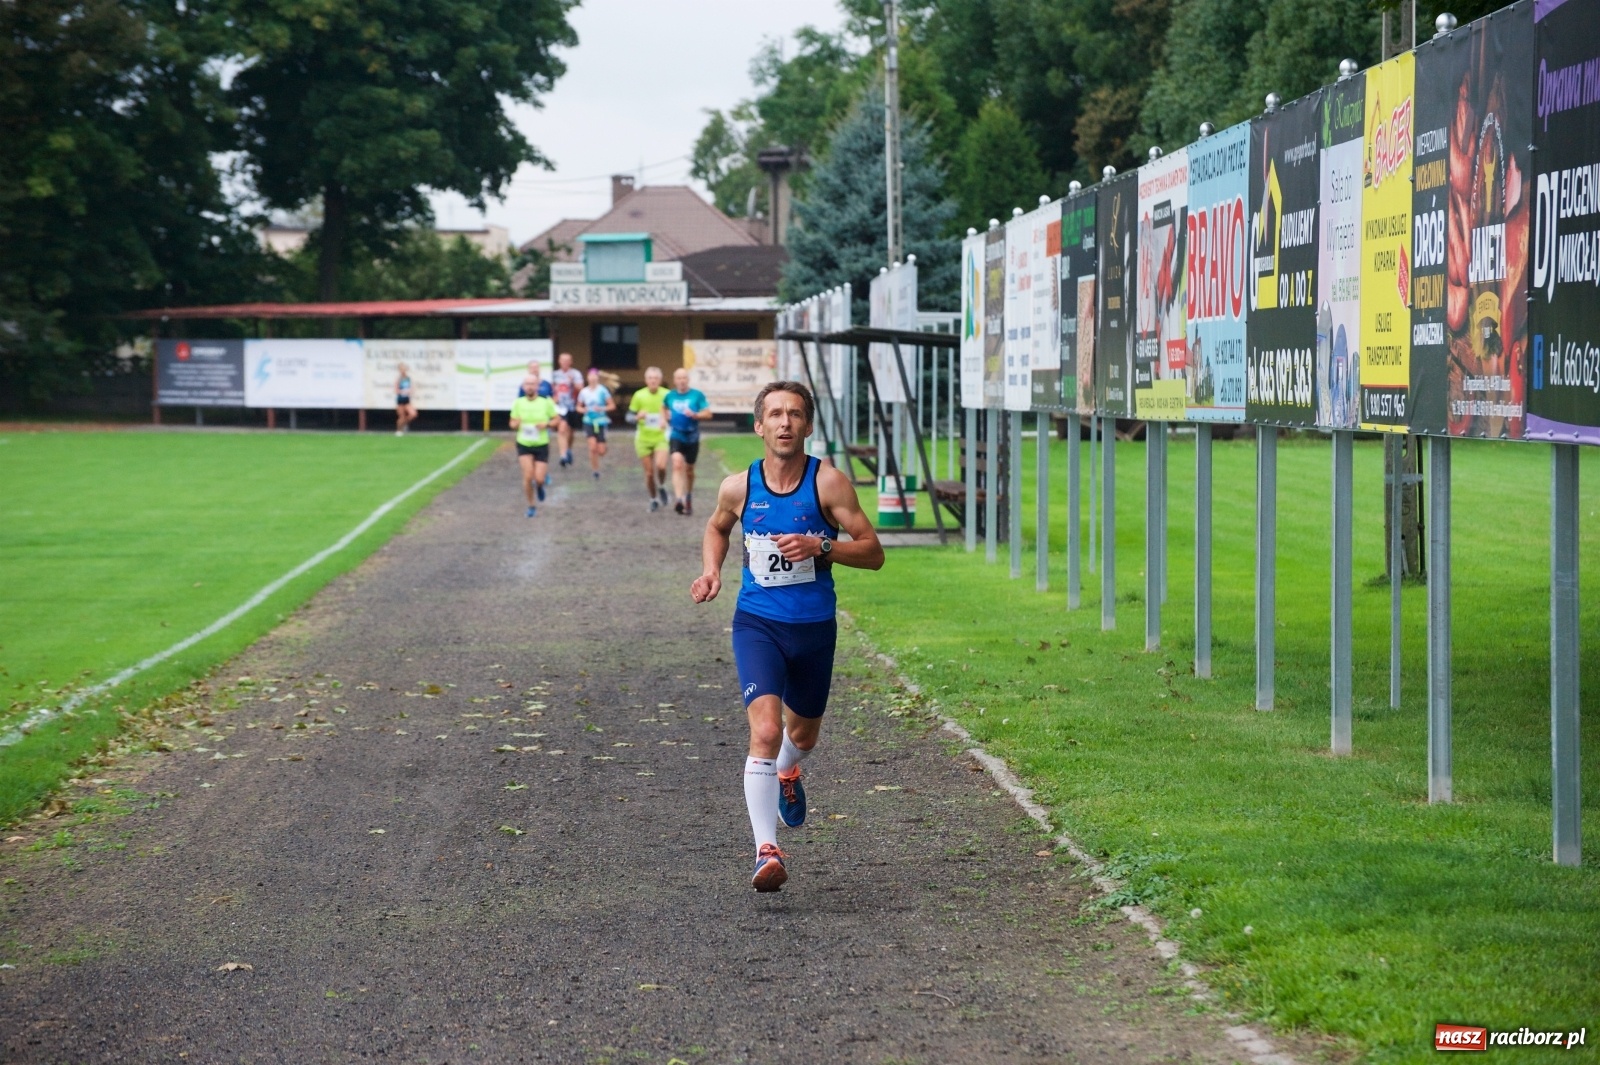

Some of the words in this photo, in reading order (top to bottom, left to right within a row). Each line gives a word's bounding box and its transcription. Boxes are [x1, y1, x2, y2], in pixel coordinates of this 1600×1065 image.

[1538, 58, 1581, 132] Oprawa
[1331, 168, 1343, 204] Sala
[1344, 166, 1353, 201] do
[1415, 159, 1446, 192] WOŁOWINA
[1281, 208, 1315, 249] BUDUJEMY
[1365, 217, 1387, 240] WYKONAM
[1414, 194, 1445, 268] DRÓB
[1534, 171, 1559, 303] DJ
[1187, 197, 1245, 320] BRAVO
[1374, 249, 1396, 275] KOPARKĄ
[1469, 223, 1506, 283] JANETA
[553, 287, 580, 304] LKS
[607, 282, 682, 303] TWORKÓW
[1280, 273, 1289, 309] OD
[1290, 272, 1295, 307] A
[1296, 270, 1306, 307] DO
[1307, 270, 1313, 305] Z
[1414, 274, 1444, 317] WĘDLINY
[1366, 346, 1402, 366] TRANSPORTOWE
[1550, 334, 1562, 385] tel.
[1564, 341, 1582, 386] 660
[1583, 341, 1600, 393] 623
[1248, 346, 1259, 405] tel.
[1260, 351, 1275, 406] 665
[1276, 348, 1293, 406] 092
[1294, 348, 1312, 408] 363
[1370, 393, 1380, 416] 880
[1380, 394, 1392, 416] 557
[768, 553, 793, 573] 26
